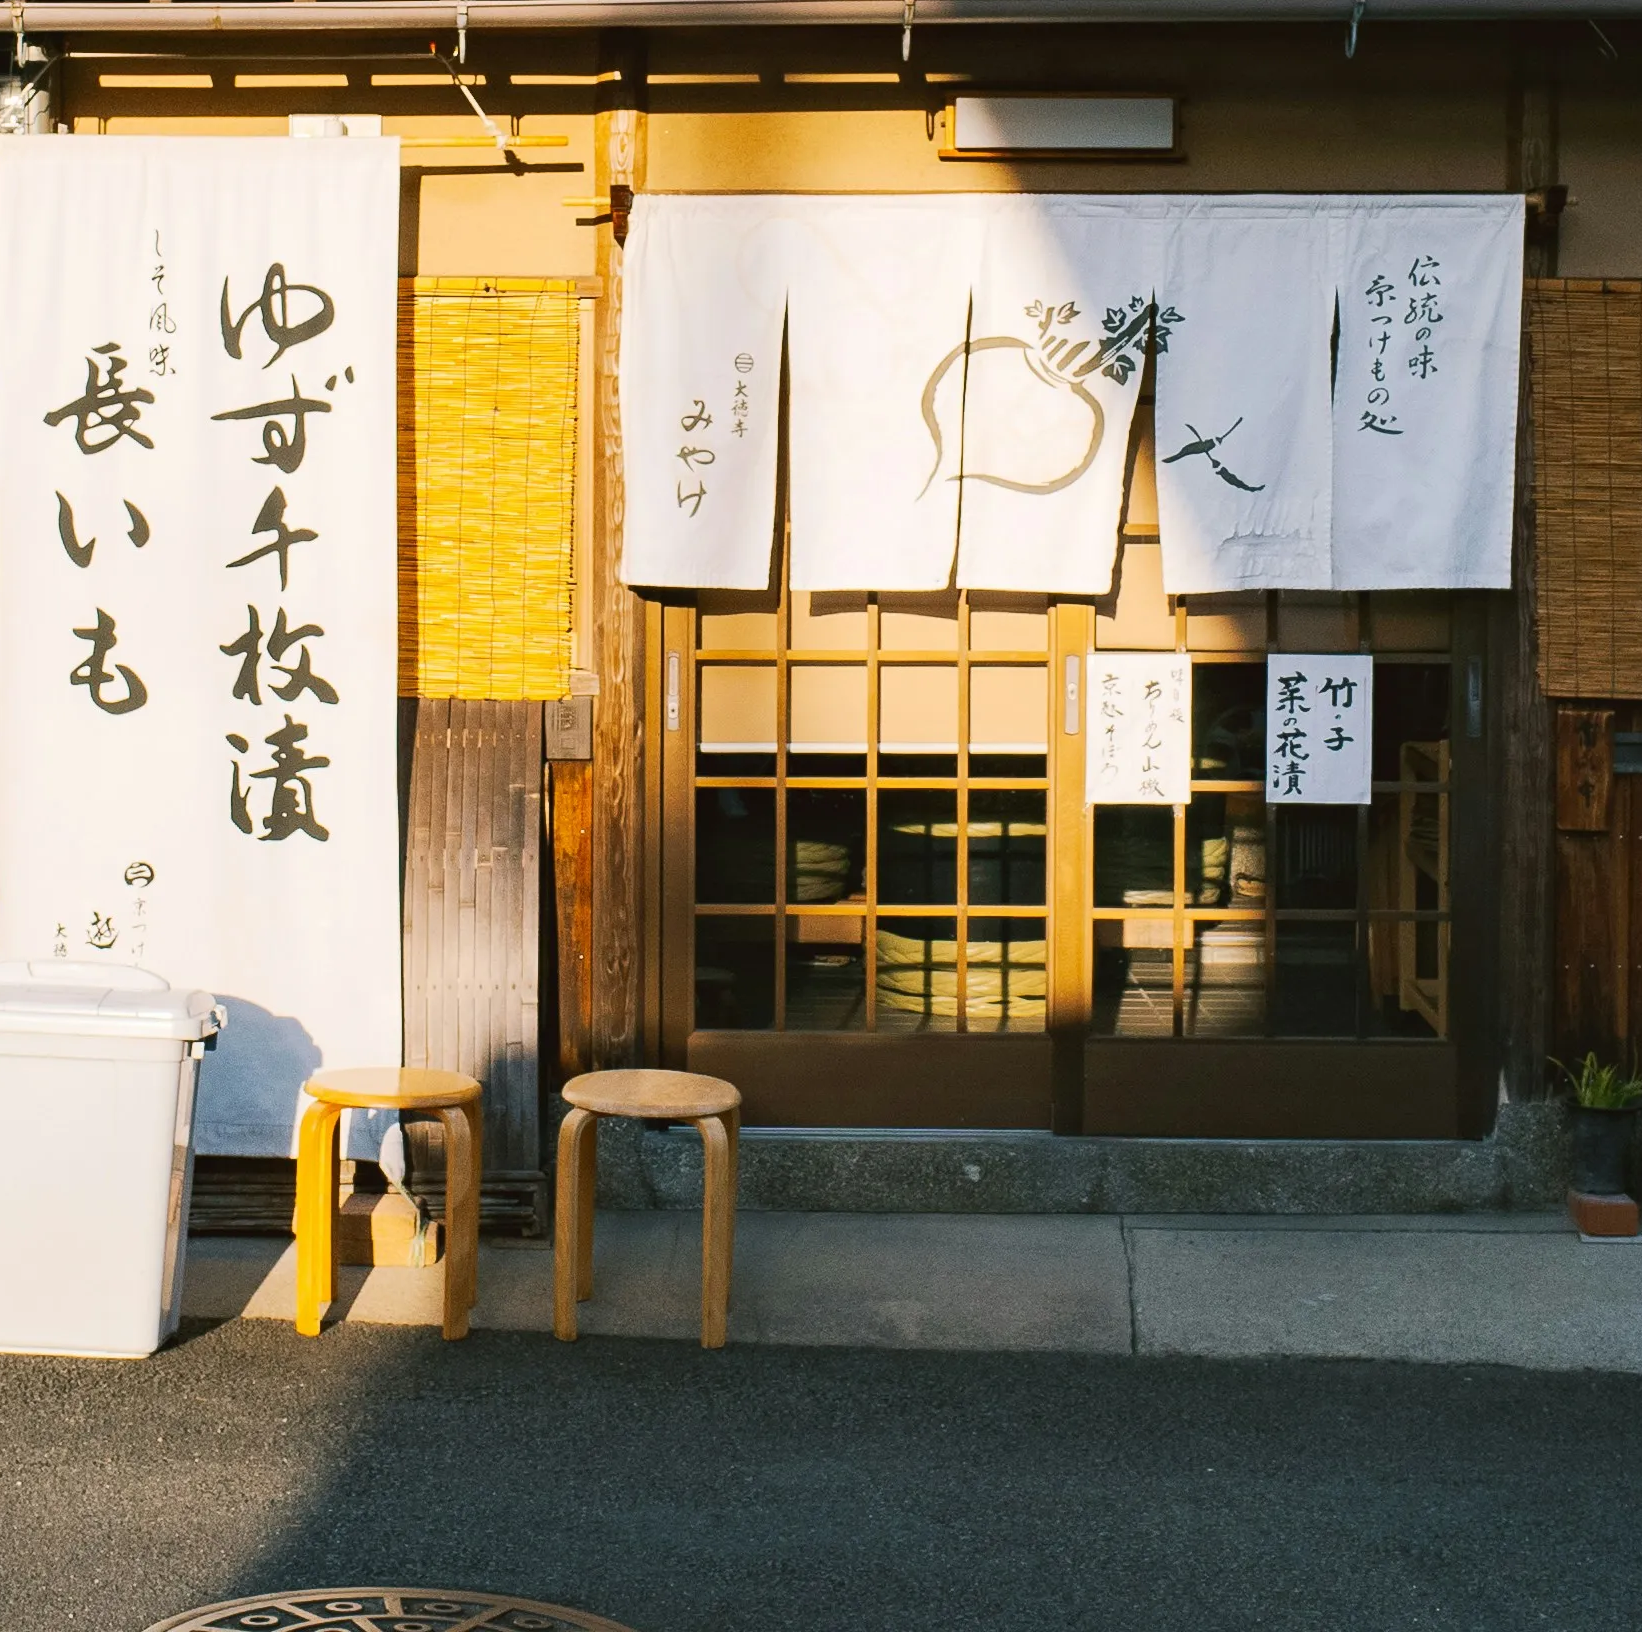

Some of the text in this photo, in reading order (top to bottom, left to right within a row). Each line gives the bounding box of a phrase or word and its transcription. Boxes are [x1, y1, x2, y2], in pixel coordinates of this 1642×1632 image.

[148, 228, 177, 376] しそ風味
[1358, 275, 1404, 436] 京つけもの処
[1404, 255, 1444, 380] 伝統の味
[677, 400, 716, 518] みやけ
[731, 380, 749, 438] 大徳寺
[43, 342, 155, 715] 長いも
[210, 263, 355, 842] ゆず千枚漬
[1273, 672, 1312, 796] 菜の花漬
[1318, 676, 1358, 751] 竹の子
